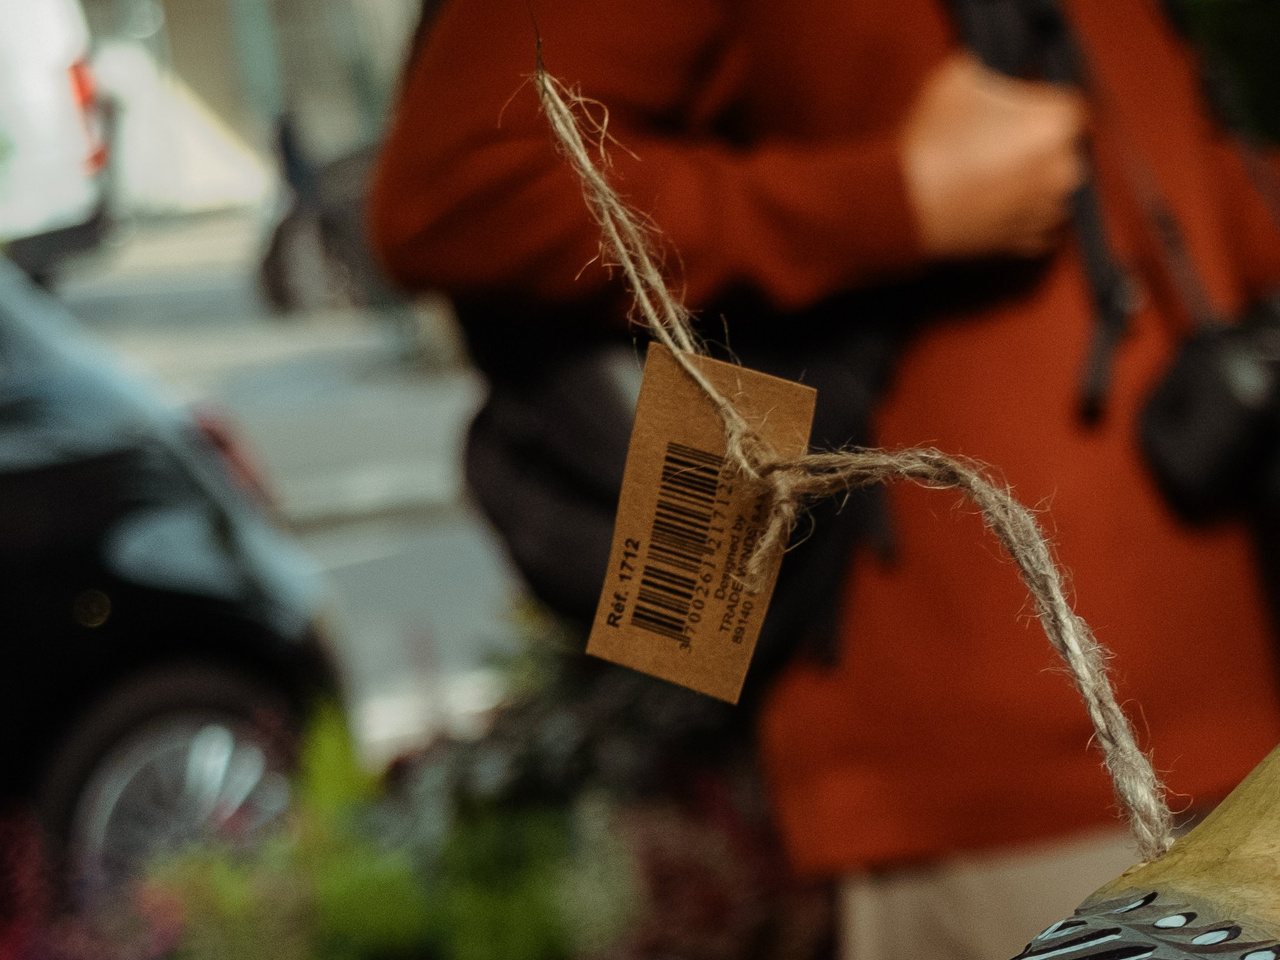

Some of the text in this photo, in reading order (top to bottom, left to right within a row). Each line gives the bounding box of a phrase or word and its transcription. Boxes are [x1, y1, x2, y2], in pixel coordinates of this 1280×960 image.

[606, 538, 640, 628] Réf. 1712
[714, 514, 747, 600] Designed by
[719, 582, 744, 632] TRADE
[732, 602, 755, 644] 89140
